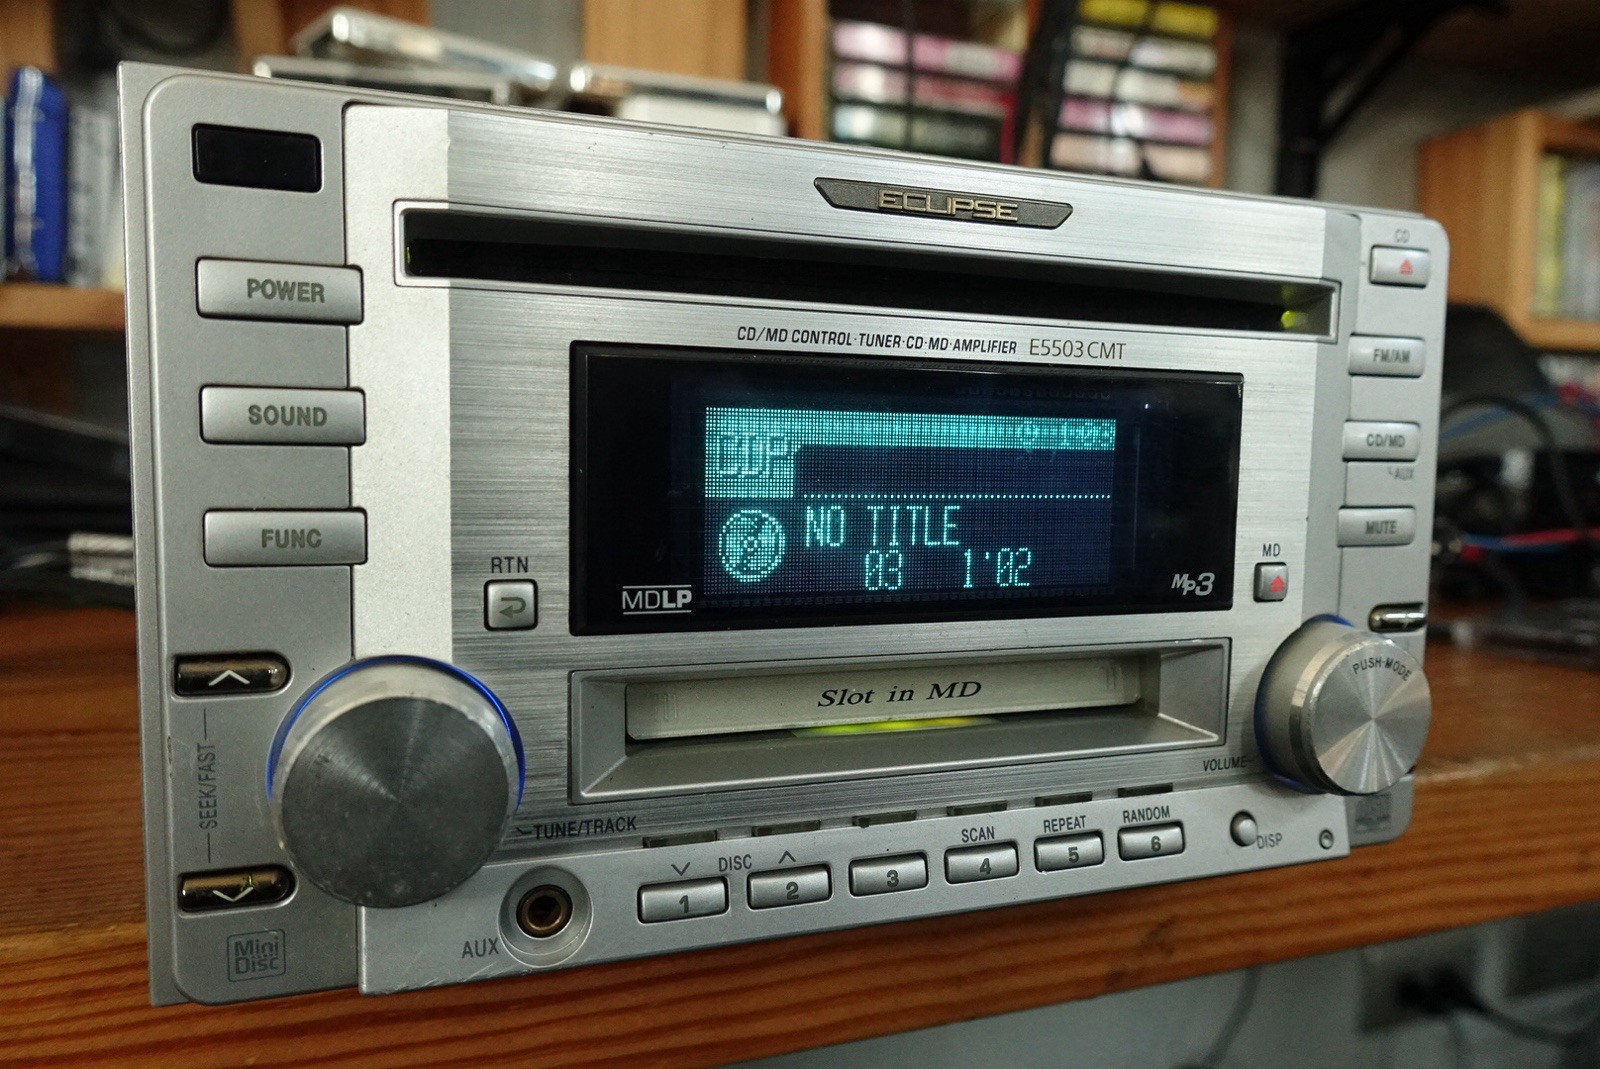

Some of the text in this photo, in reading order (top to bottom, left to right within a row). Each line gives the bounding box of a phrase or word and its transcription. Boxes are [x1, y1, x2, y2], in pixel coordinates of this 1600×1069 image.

[879, 189, 1018, 222] ECLIPSE
[246, 278, 326, 304] POWER
[736, 326, 789, 343] CD/MD
[1029, 338, 1084, 358] E5503
[1087, 341, 1128, 360] CMT
[1372, 348, 1411, 364] FM/AM
[248, 405, 328, 428] SOUND
[1366, 433, 1406, 449] CD/MD
[717, 432, 791, 478] CDP
[806, 505, 961, 547] NO TITLE
[1365, 520, 1397, 535] MUTE
[261, 528, 322, 550] FUNC
[1262, 543, 1281, 557] MD
[491, 556, 529, 574] RTN
[865, 549, 903, 592] 03
[621, 588, 693, 610] MDLP
[817, 680, 982, 708] Slot in MD
[1202, 755, 1247, 773] VOLUME
[197, 743, 218, 831] SEEK/FAST
[1043, 814, 1087, 833] REPEAT
[1122, 805, 1171, 824] RANDOM
[533, 815, 637, 840] TUNE/TRACK
[961, 825, 996, 844] SCAN
[1150, 835, 1162, 853] 6
[1256, 832, 1283, 850] DISP
[718, 854, 753, 872] DISC
[1068, 846, 1079, 864] 5
[979, 857, 992, 876] 4
[886, 869, 899, 888] 3
[786, 882, 799, 900] 2
[678, 895, 690, 914] 1
[235, 935, 279, 957] Mini
[461, 937, 499, 959] AUX
[235, 955, 279, 974] Disc
